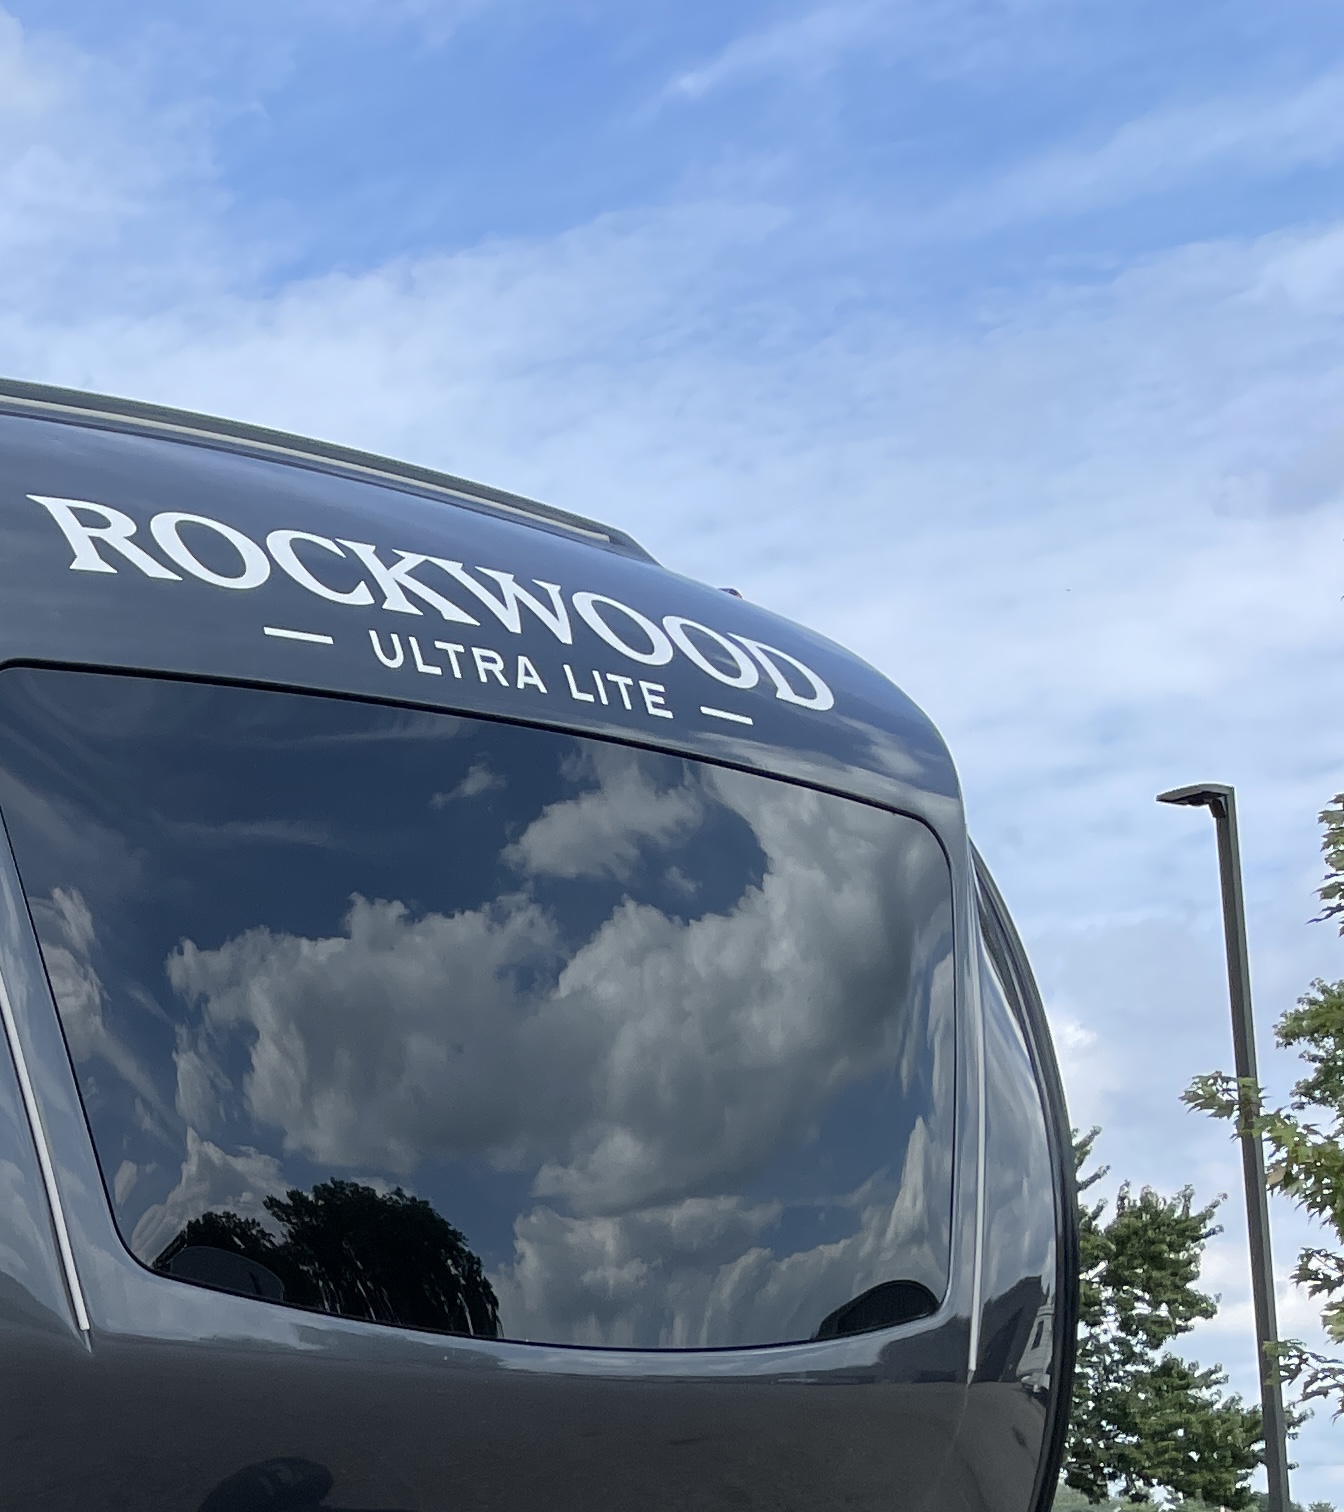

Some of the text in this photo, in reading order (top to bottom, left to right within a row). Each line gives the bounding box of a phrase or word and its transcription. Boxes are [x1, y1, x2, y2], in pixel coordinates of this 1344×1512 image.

[25, 493, 836, 711] ROCKWOOD
[368, 629, 674, 720] ULTRA LITE
